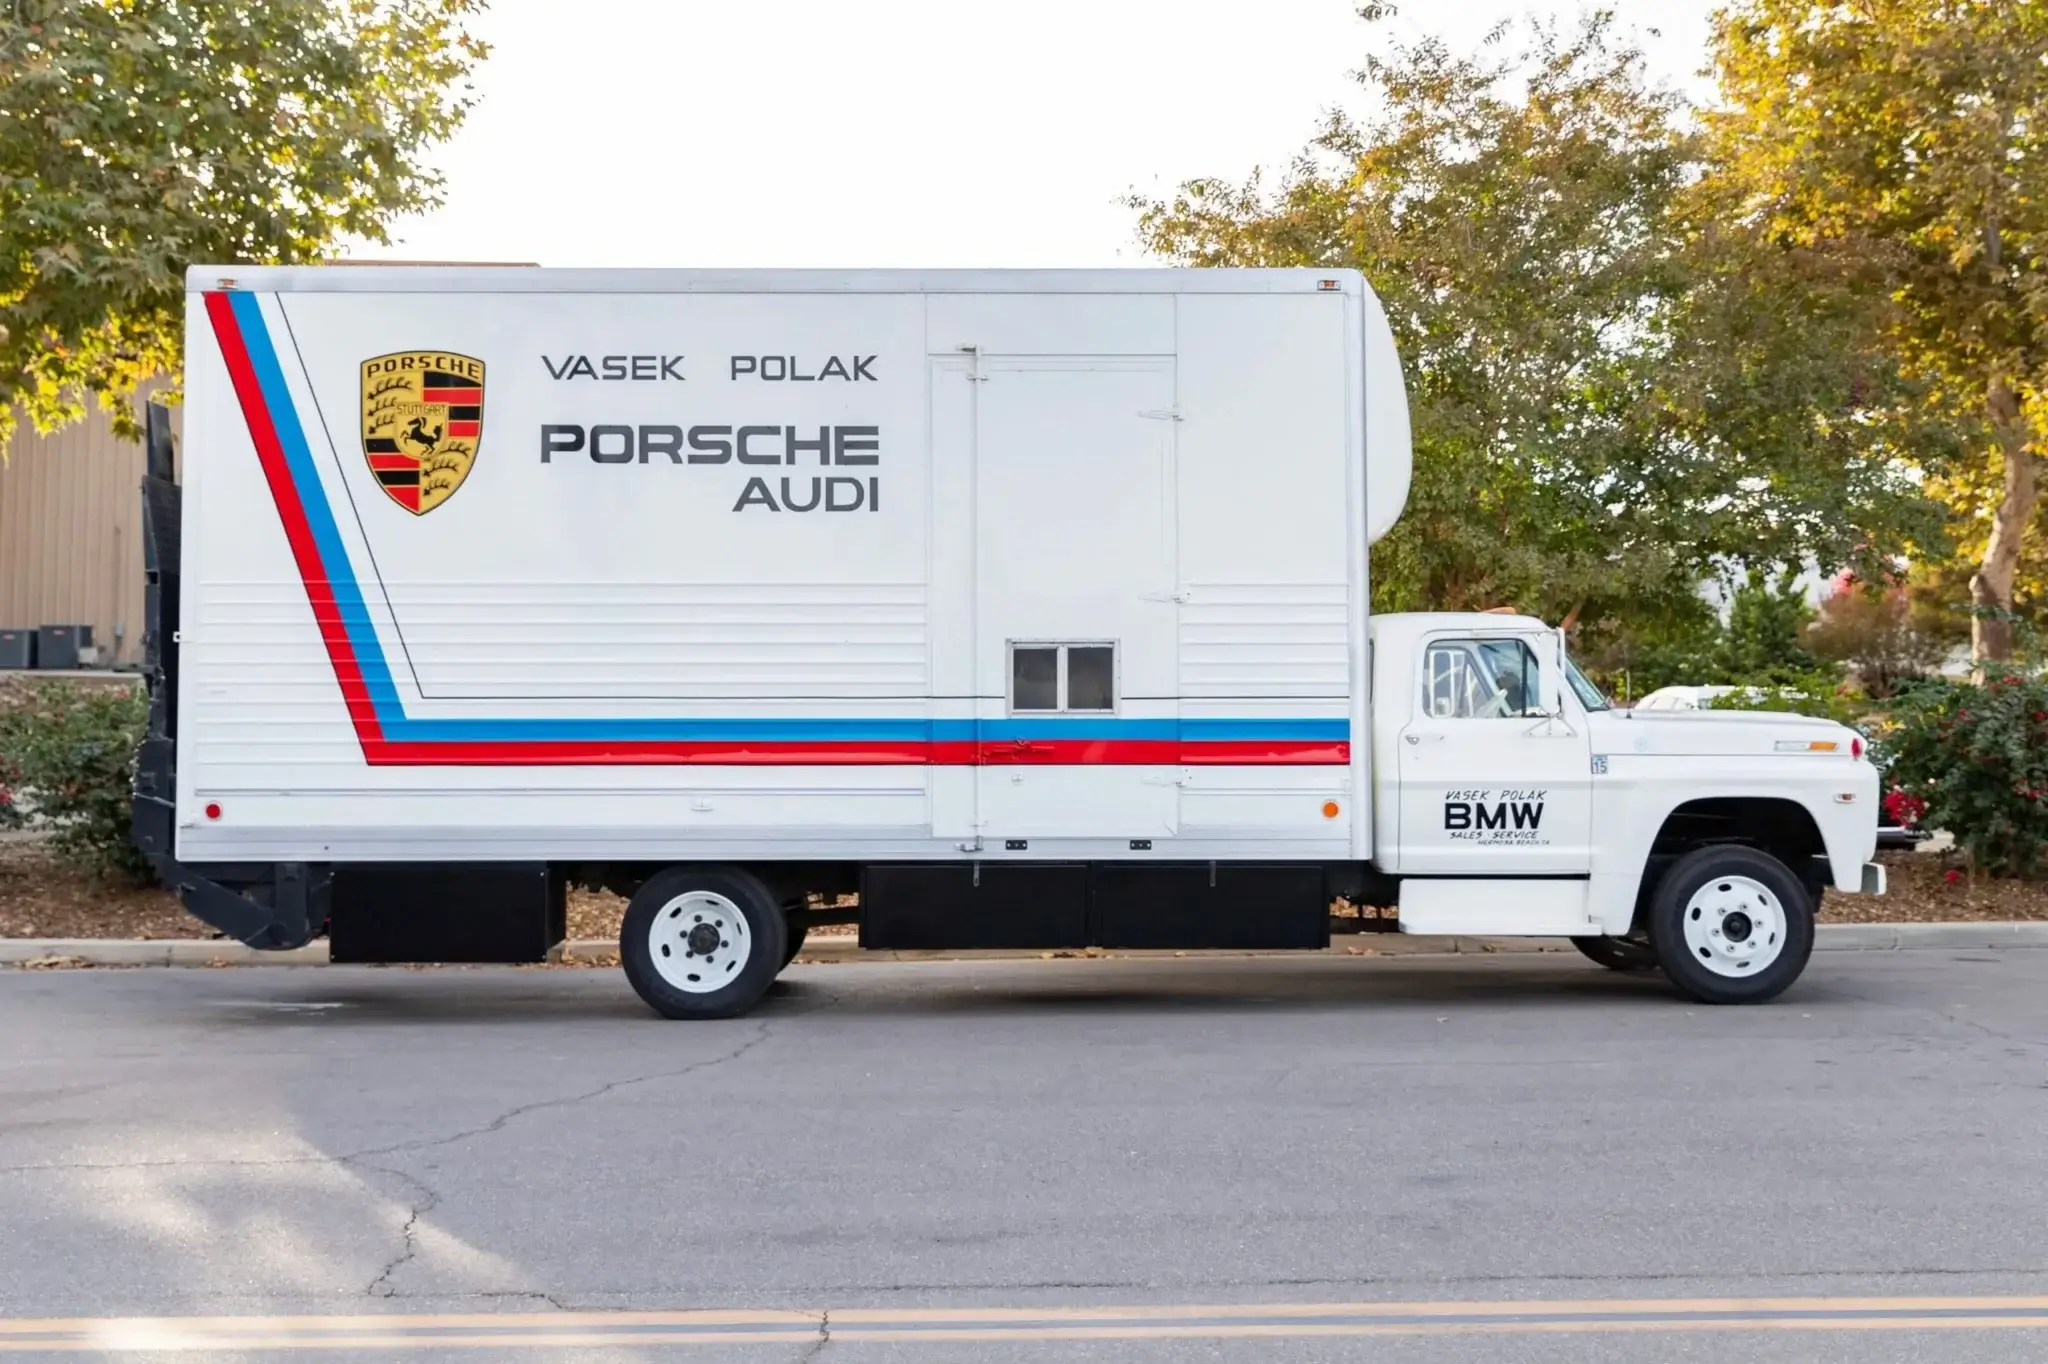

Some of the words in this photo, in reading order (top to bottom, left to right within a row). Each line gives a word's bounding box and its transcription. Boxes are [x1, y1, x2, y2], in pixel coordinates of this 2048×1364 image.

[367, 355, 480, 379] PORSCHE
[541, 355, 685, 381] VASEK
[731, 355, 878, 381] POLAK
[397, 404, 445, 415] STUTTGART
[540, 424, 879, 466] PORSCHE
[732, 476, 879, 512] AUDI
[1445, 790, 1490, 801] VASEK
[1500, 790, 1547, 801] POLAK
[1444, 802, 1544, 830] BMW
[1450, 831, 1483, 839] SALES
[1492, 831, 1539, 839] SERVICE
